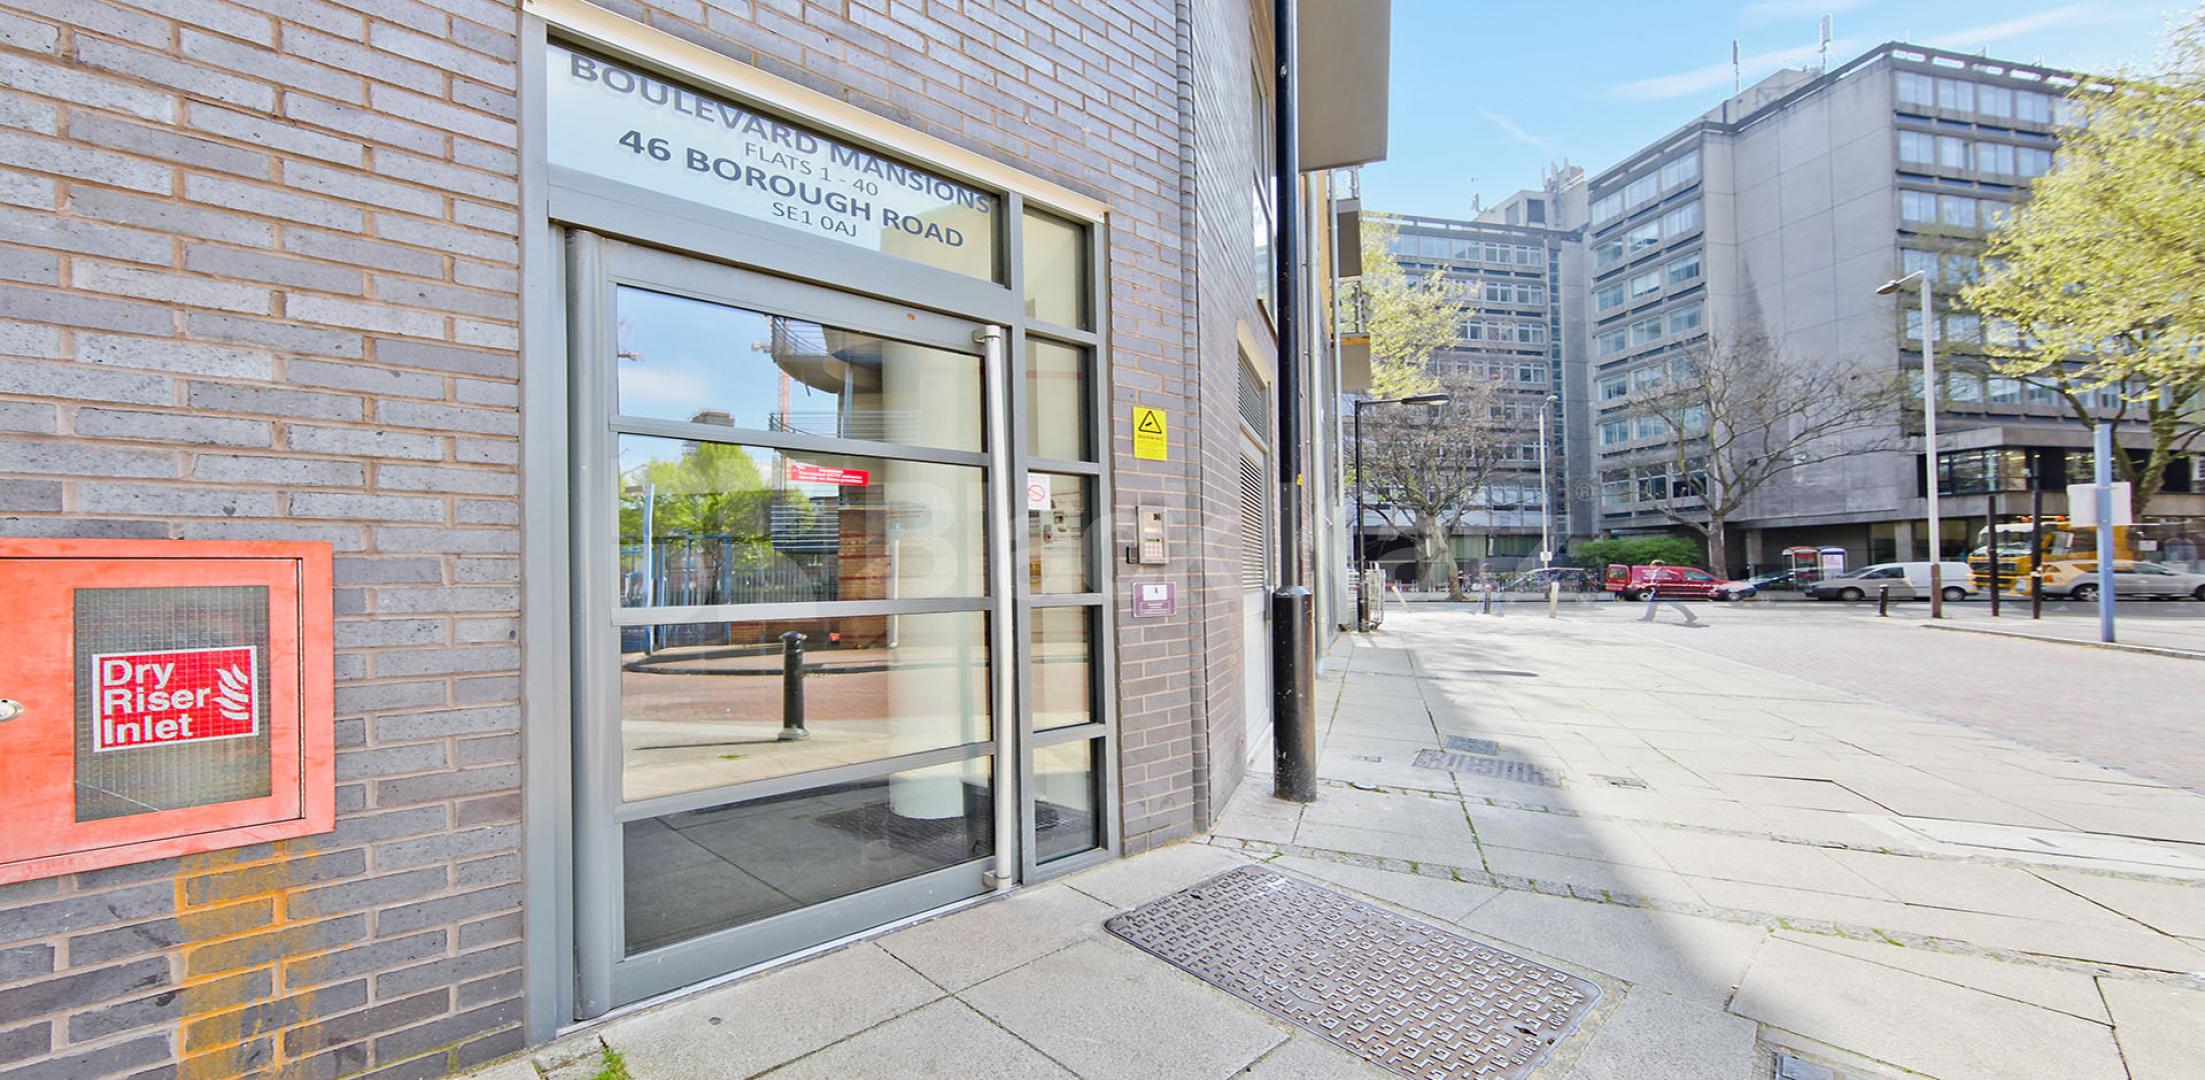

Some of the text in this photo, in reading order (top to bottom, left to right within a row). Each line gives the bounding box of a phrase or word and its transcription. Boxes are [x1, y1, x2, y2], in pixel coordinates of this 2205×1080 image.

[570, 52, 991, 215] BOULEVARD MANSIONS
[744, 142, 812, 175] FLATS
[820, 166, 832, 183] 1
[852, 177, 879, 197] 40
[618, 129, 965, 249] 46 BOROUGH ROAD
[772, 201, 812, 226] SE1
[102, 658, 176, 690] Dry
[102, 686, 212, 716] Riser
[103, 713, 194, 745] Inlet
